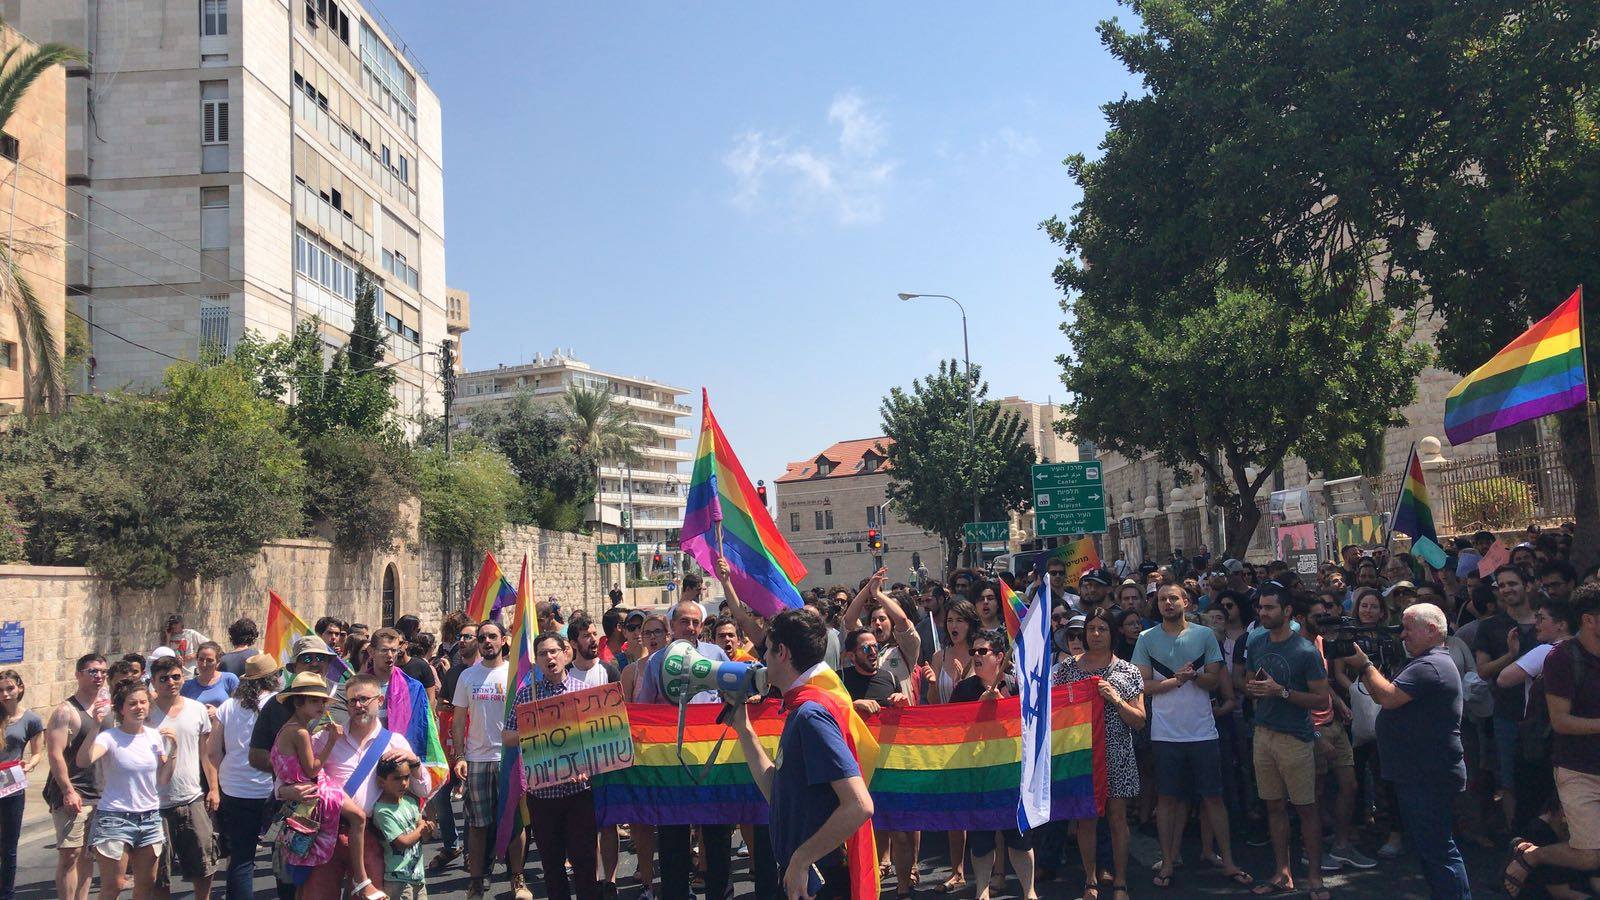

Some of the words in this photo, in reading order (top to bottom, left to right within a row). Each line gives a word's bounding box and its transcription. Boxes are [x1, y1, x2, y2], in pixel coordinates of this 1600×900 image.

[573, 688, 623, 712] מתי
[521, 701, 565, 728] יהיה
[585, 714, 623, 738] חוק
[585, 737, 634, 776] שוויון
